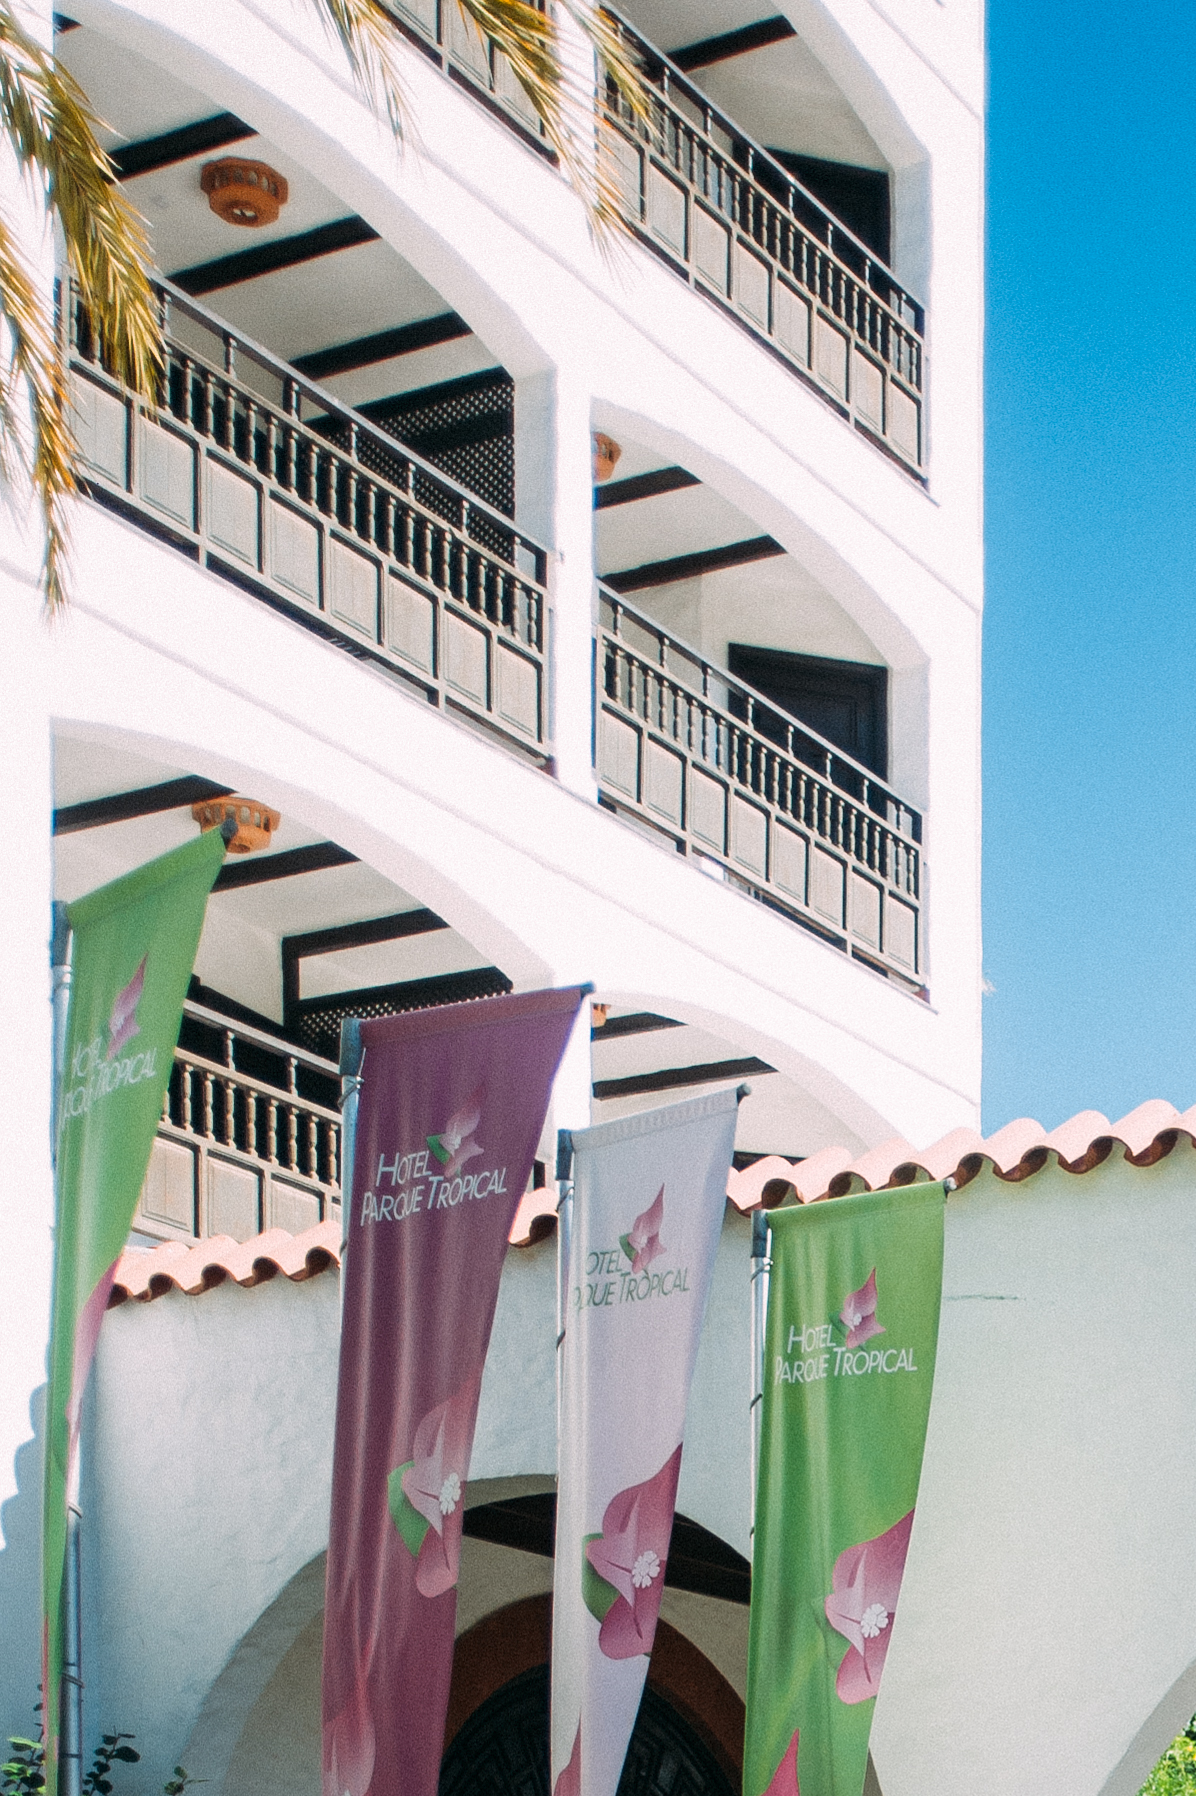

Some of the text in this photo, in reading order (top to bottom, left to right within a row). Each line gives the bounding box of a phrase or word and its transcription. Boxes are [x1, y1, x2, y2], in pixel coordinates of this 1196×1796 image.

[376, 1150, 432, 1187] HOTEL
[360, 1167, 508, 1226] PARQUE TROPICAL
[585, 1250, 623, 1275] OTEL
[619, 1267, 691, 1304] TROPICAL
[787, 1324, 837, 1353] HOTEL
[774, 1347, 918, 1385] PARQUE TROPICAL
